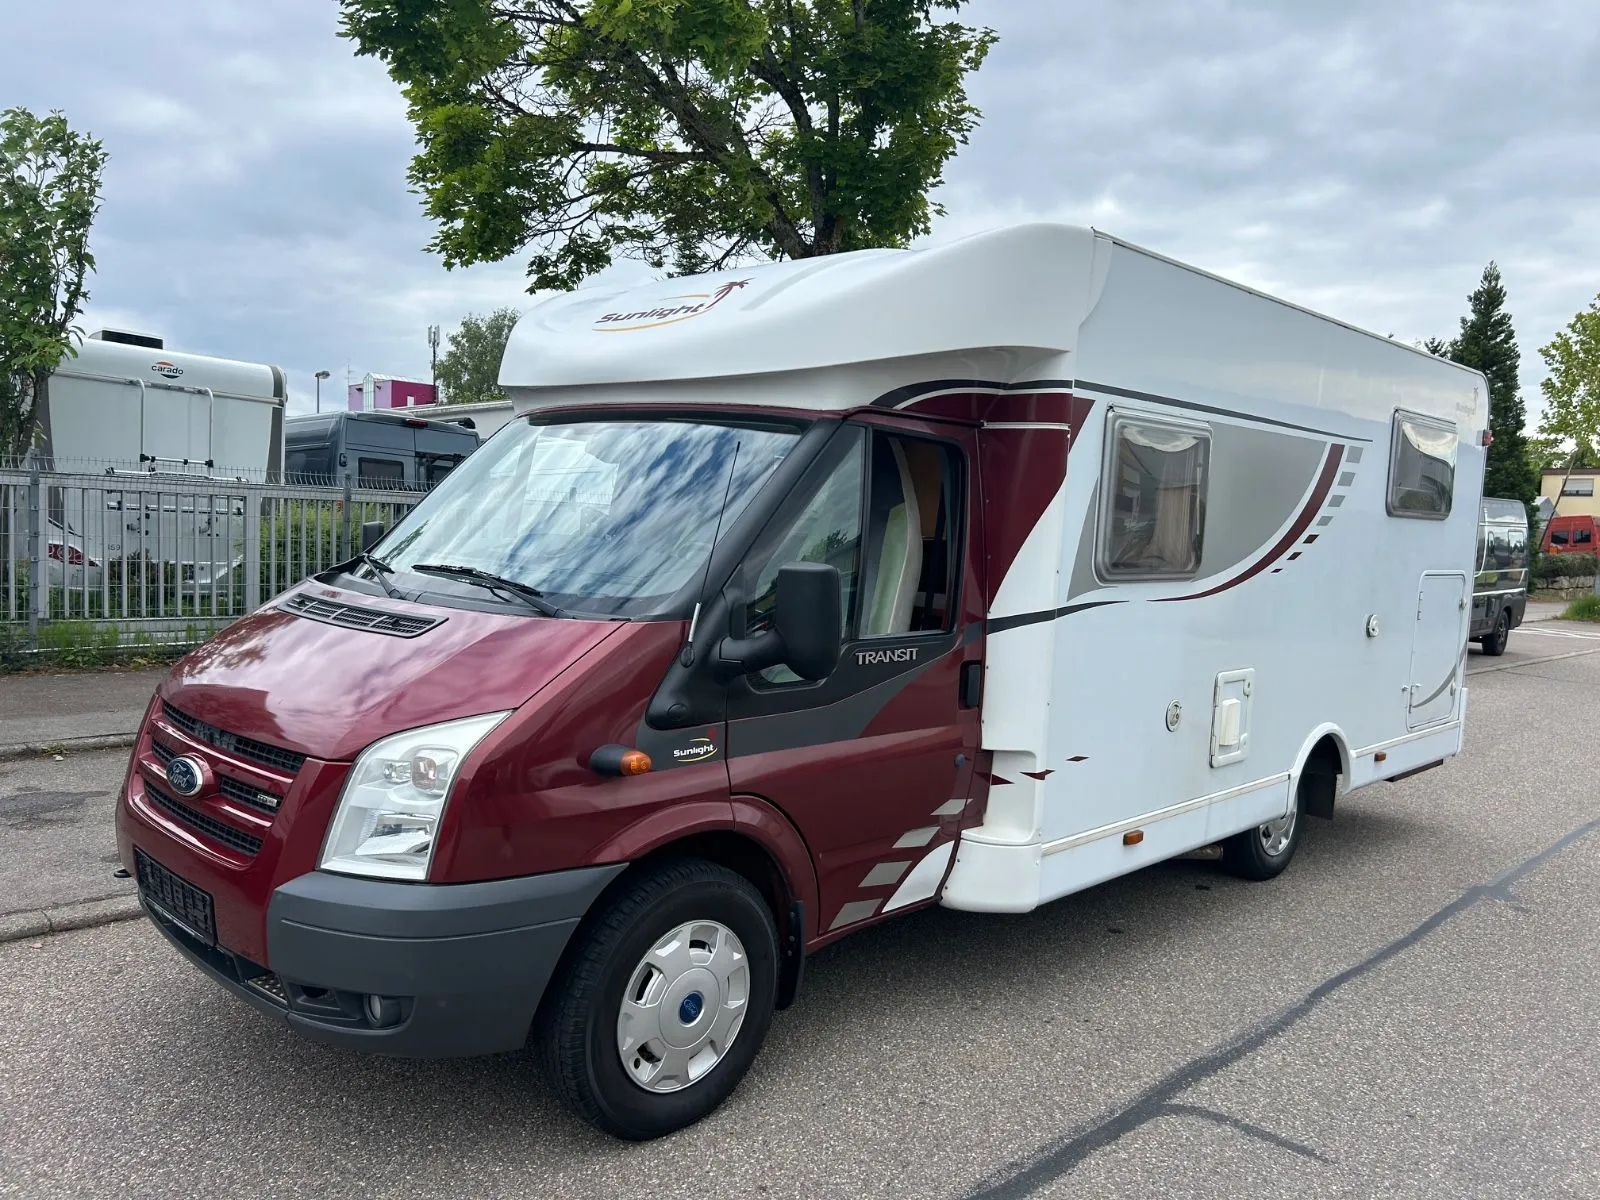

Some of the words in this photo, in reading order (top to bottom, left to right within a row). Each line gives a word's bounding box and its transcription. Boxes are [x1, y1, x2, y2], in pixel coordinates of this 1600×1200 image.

[594, 303, 705, 323] Sunlight
[151, 365, 184, 375] carado
[855, 648, 919, 665] TRANSIT
[673, 744, 714, 757] Sunlight
[171, 762, 191, 788] Ford
